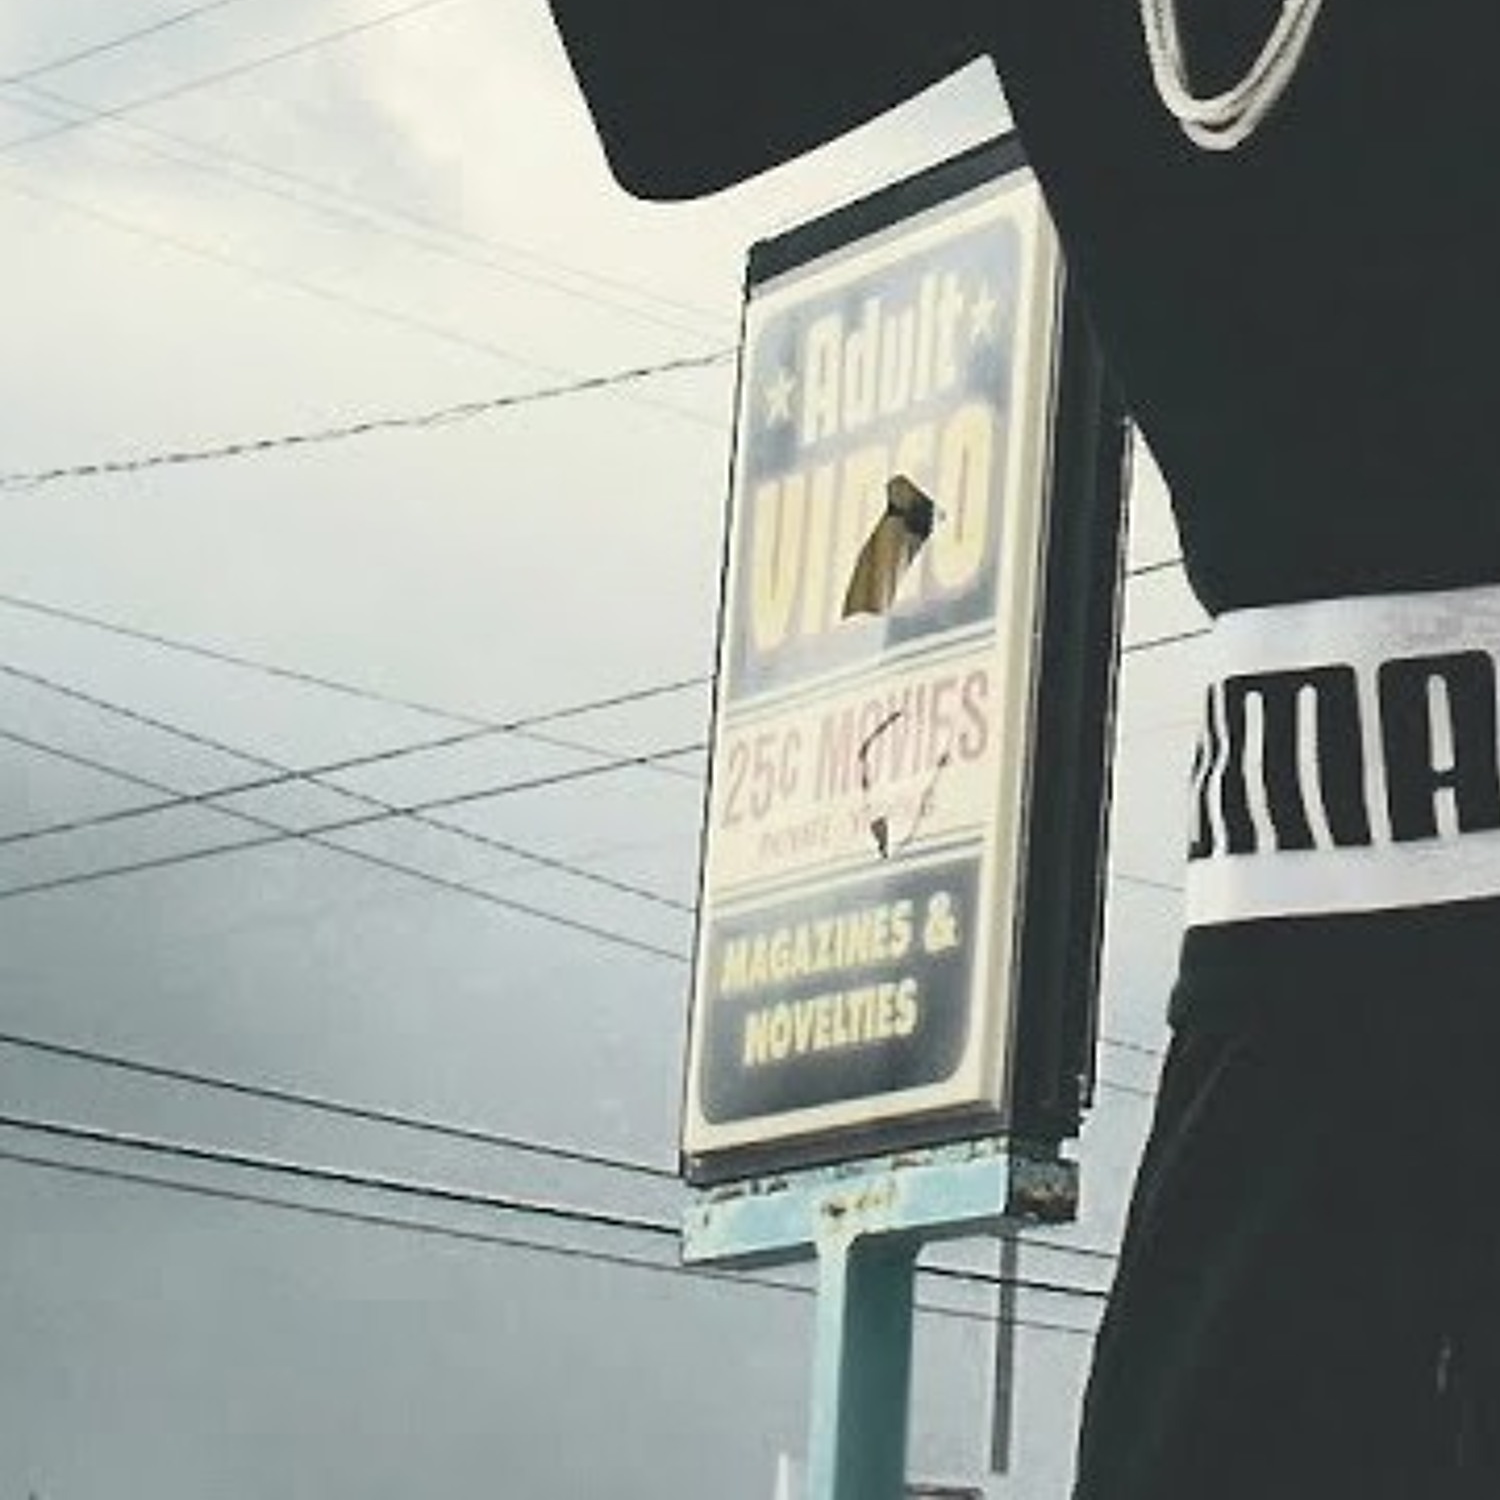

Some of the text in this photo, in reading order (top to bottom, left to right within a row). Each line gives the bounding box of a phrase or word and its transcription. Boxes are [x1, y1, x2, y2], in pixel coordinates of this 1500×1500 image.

[803, 271, 968, 445] Adult
[751, 402, 996, 654] VIO
[814, 668, 990, 803] MOVIES
[719, 891, 959, 993] MAGAZINES &
[742, 978, 919, 1067] NOVELTIES
